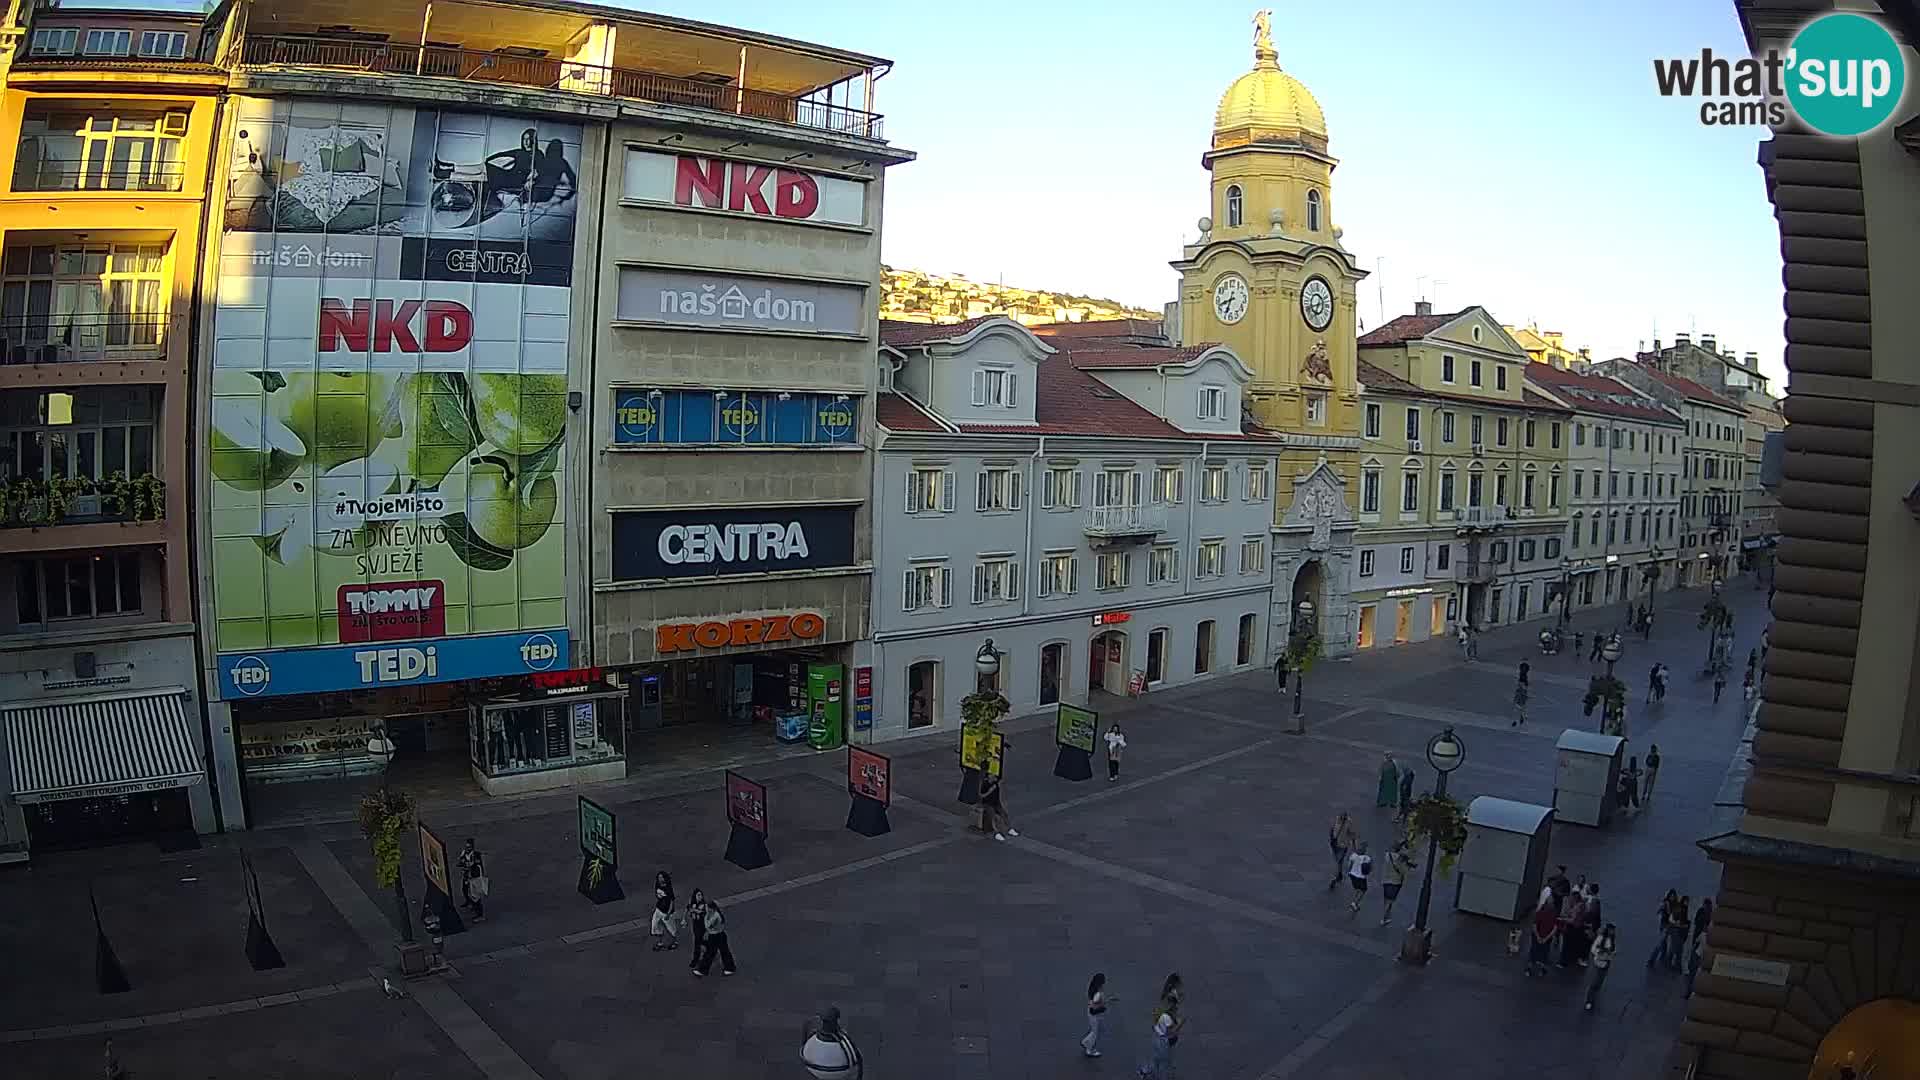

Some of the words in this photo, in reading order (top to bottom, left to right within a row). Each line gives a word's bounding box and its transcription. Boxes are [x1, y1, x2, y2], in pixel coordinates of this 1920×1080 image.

[674, 154, 819, 219] NKD
[316, 244, 363, 268] dom
[446, 249, 533, 275] CENTRA
[660, 284, 717, 316] naš
[753, 289, 816, 322] dom
[319, 297, 474, 353] NKD
[617, 407, 656, 425] TEDi
[722, 409, 759, 426] TEDi
[819, 411, 853, 427] TEDi
[335, 496, 444, 517] #TvojeMisto
[330, 529, 354, 550] ZA
[364, 523, 449, 549] DNEVNO
[657, 521, 809, 564] CENTRA
[357, 548, 424, 576] SVJEŽE
[346, 587, 436, 615] TOMMY
[657, 613, 824, 653] KORZO
[354, 646, 438, 684] TEDi
[521, 643, 558, 662] TEDi
[230, 665, 271, 685] TEDi
